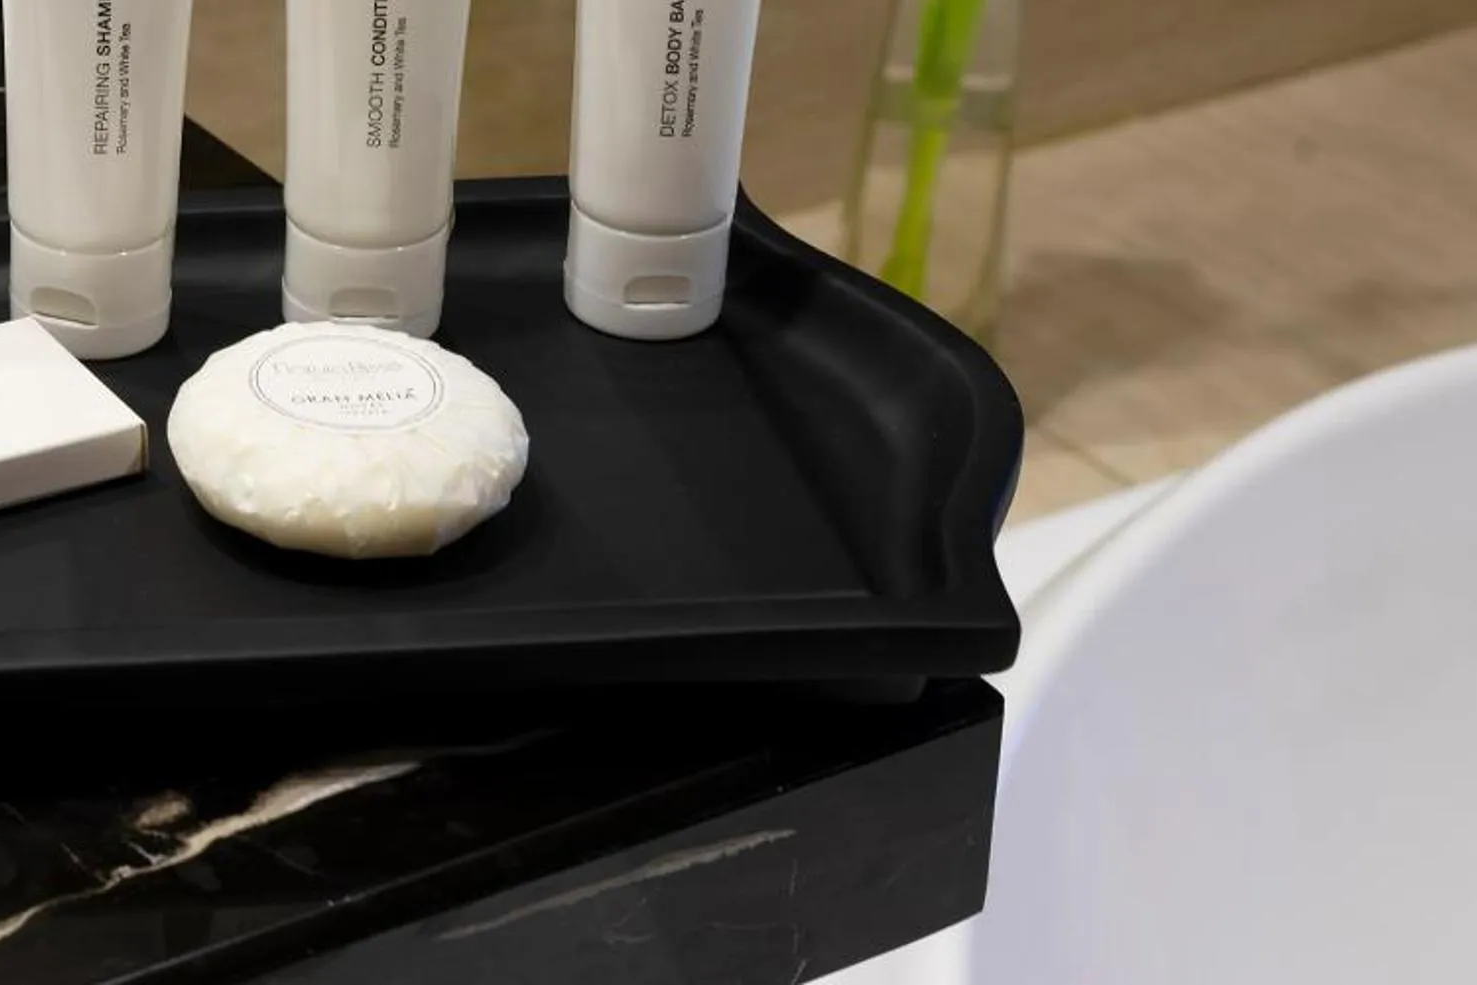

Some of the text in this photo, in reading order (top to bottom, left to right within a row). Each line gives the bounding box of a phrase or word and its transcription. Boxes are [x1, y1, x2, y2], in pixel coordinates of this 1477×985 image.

[665, 27, 683, 75] BODY
[92, 63, 112, 155] REPAIRING
[366, 72, 385, 149] SMOOTH
[659, 80, 678, 137] DETOX
